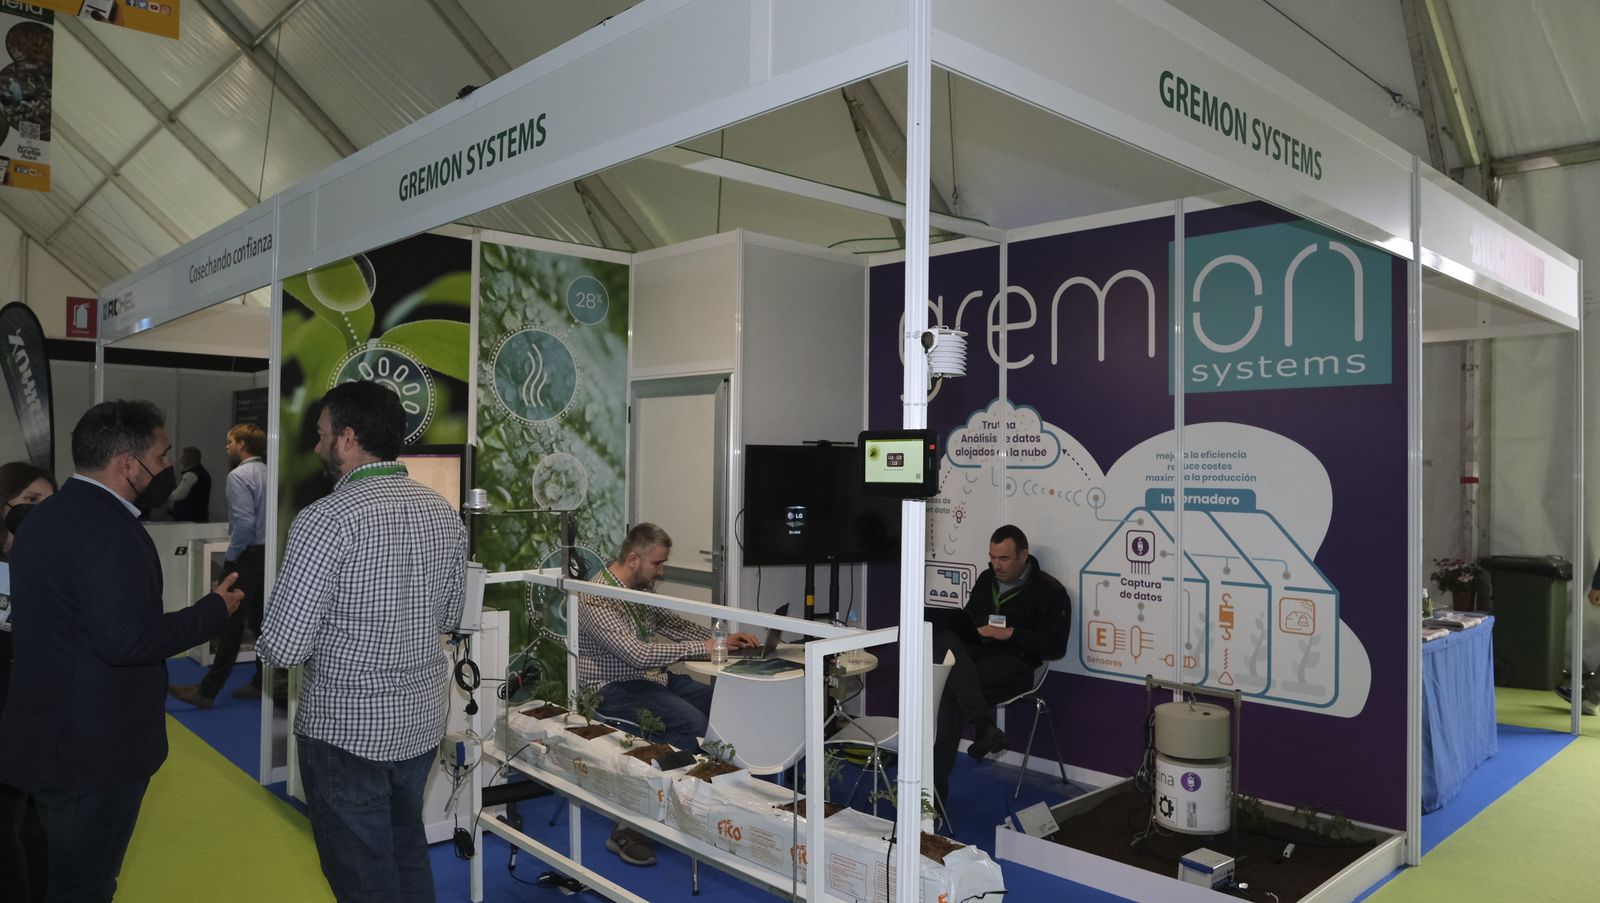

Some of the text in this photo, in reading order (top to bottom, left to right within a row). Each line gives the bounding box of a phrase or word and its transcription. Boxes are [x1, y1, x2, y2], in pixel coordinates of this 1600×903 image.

[1159, 70, 1323, 181] GREMON SYSTEMS
[398, 112, 547, 202] GREMON SYSTEMS
[189, 233, 273, 284] Cosechando confianza
[1191, 353, 1367, 387] systems
[961, 433, 998, 443] Análisis
[1012, 434, 1041, 443] datos
[955, 447, 995, 459] alojados
[1010, 448, 1019, 457] la
[1021, 448, 1047, 457] nube
[1190, 450, 1199, 459] la
[1200, 450, 1247, 459] eficiencia
[1201, 462, 1233, 470] costes
[1191, 473, 1201, 481] la
[1202, 473, 1257, 483] producción
[1120, 577, 1162, 590] Captura
[1119, 590, 1163, 602] de datos
[1086, 655, 1123, 668] Sensores
